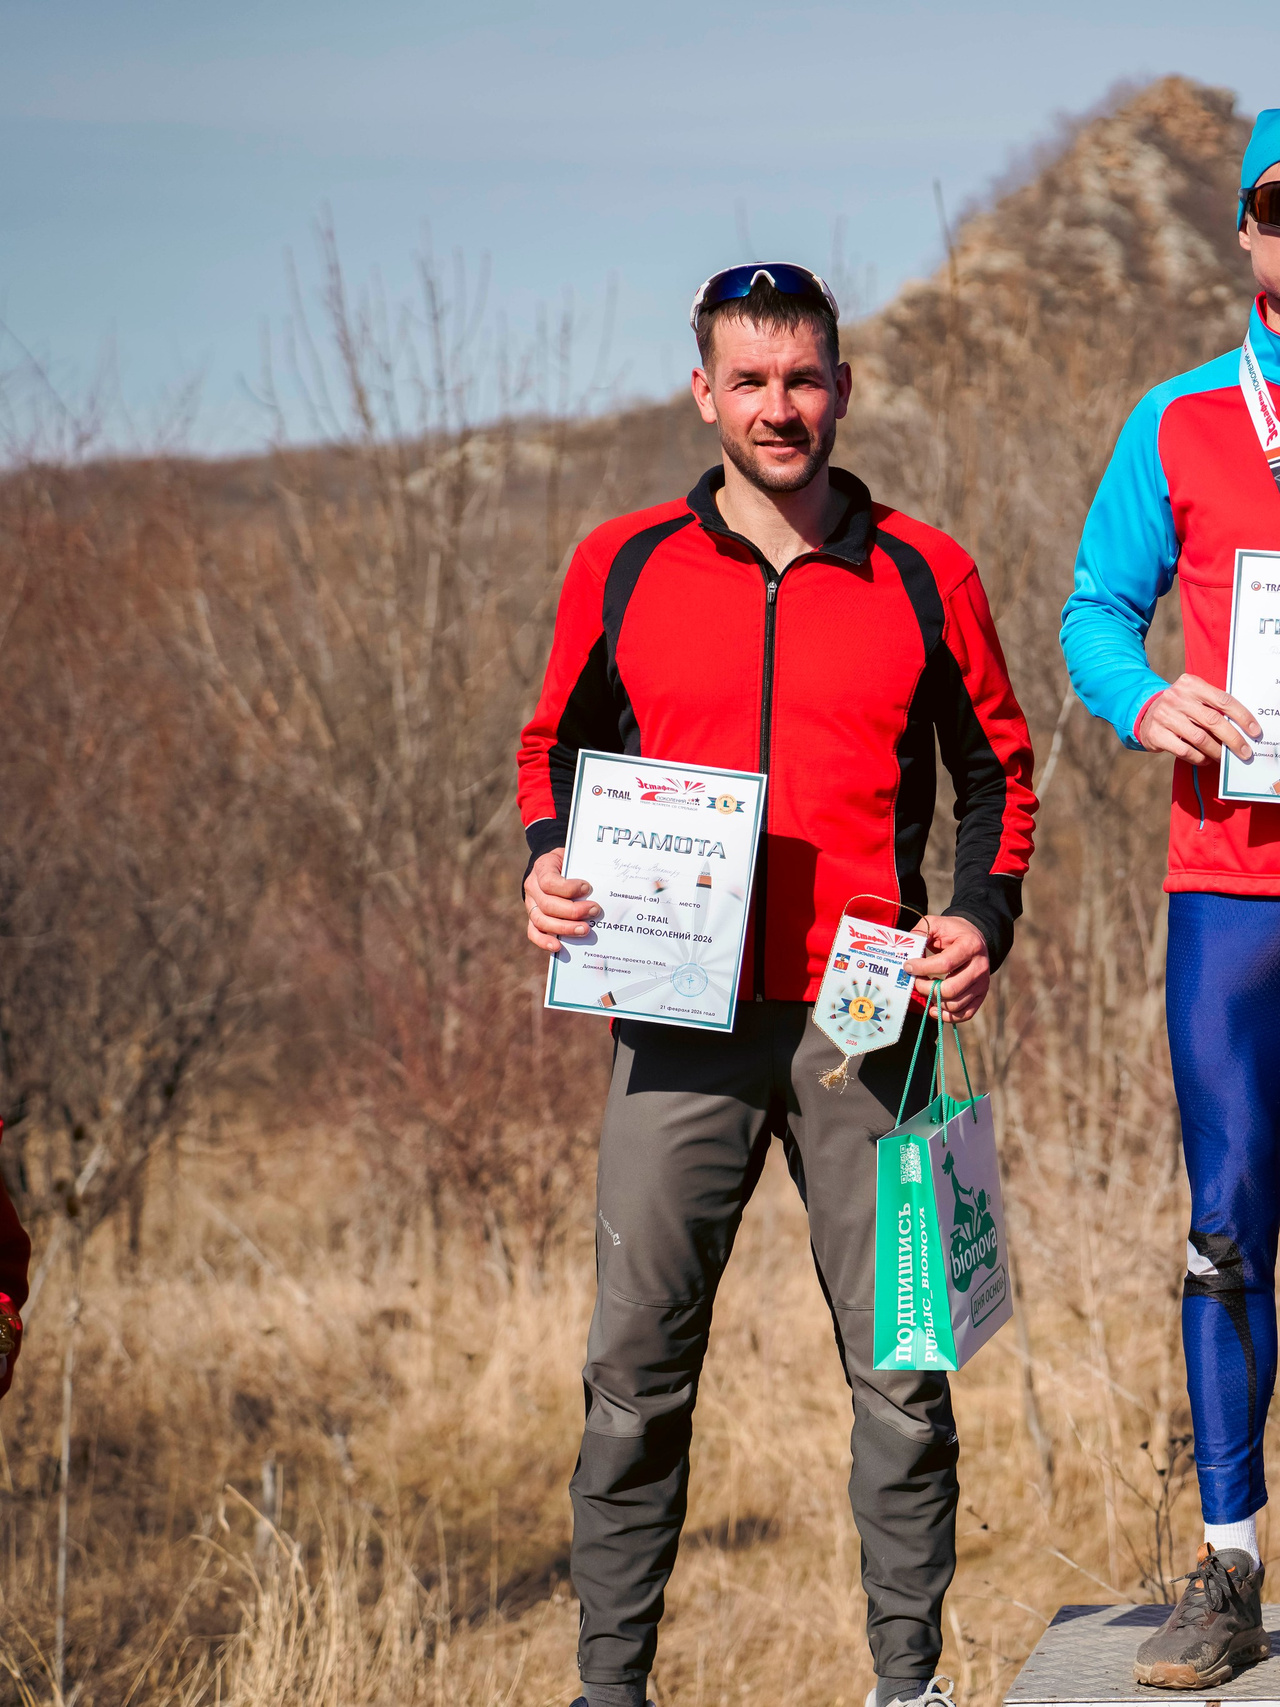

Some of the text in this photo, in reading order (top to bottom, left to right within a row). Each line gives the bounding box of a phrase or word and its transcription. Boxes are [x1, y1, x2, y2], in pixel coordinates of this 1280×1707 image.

[596, 824, 726, 860] ГРАМОТА
[609, 890, 643, 901] Занявший
[636, 913, 669, 924] O-TRAIL
[589, 920, 713, 944] ЭСТАФЕТА ПОКОЛЕНИЙ 2026
[622, 957, 646, 965] проекта
[667, 1006, 690, 1014] февраля
[950, 1226, 997, 1280] bionova
[896, 1202, 916, 1362] ПОДПИШИСЬ
[919, 1206, 938, 1363] PUBLIC_BIONOVA
[973, 1298, 986, 1318] ДНЯ
